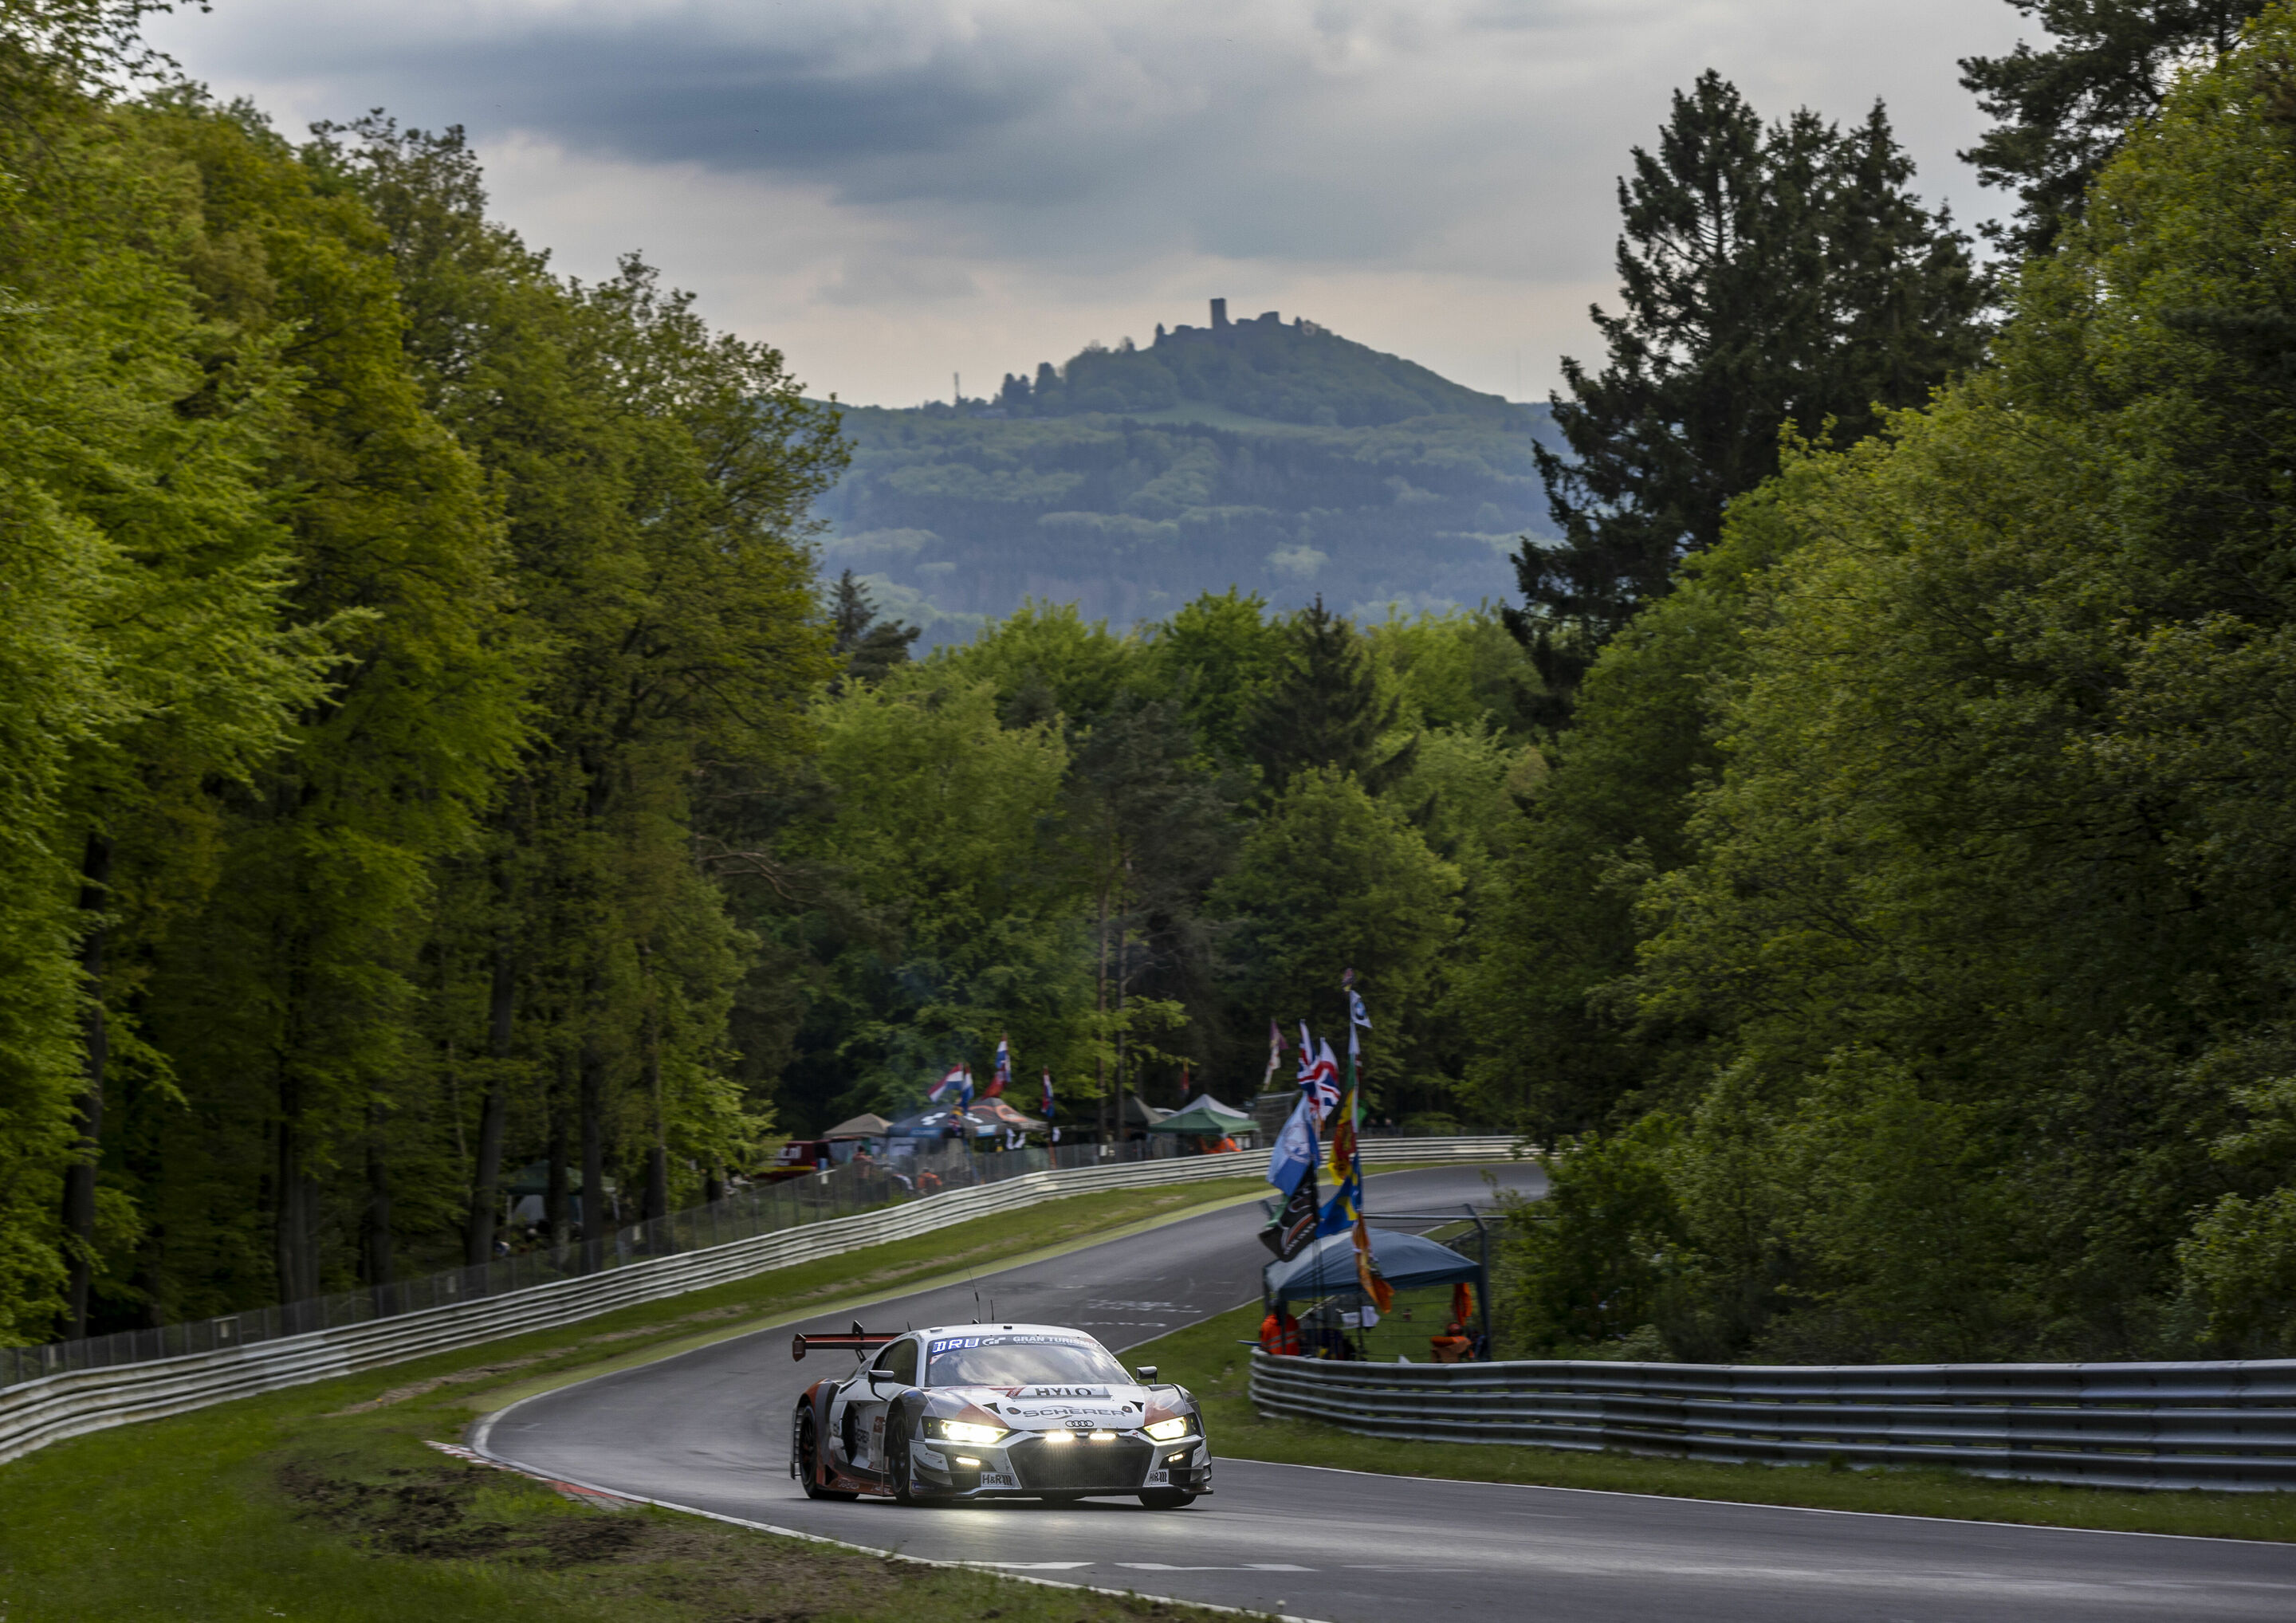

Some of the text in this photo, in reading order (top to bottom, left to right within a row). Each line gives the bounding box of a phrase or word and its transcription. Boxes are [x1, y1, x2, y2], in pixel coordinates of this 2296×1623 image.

[1048, 1337, 1098, 1348] TURISMO
[1023, 1408, 1126, 1417] SCHERER
[982, 1474, 1002, 1484] H&R
